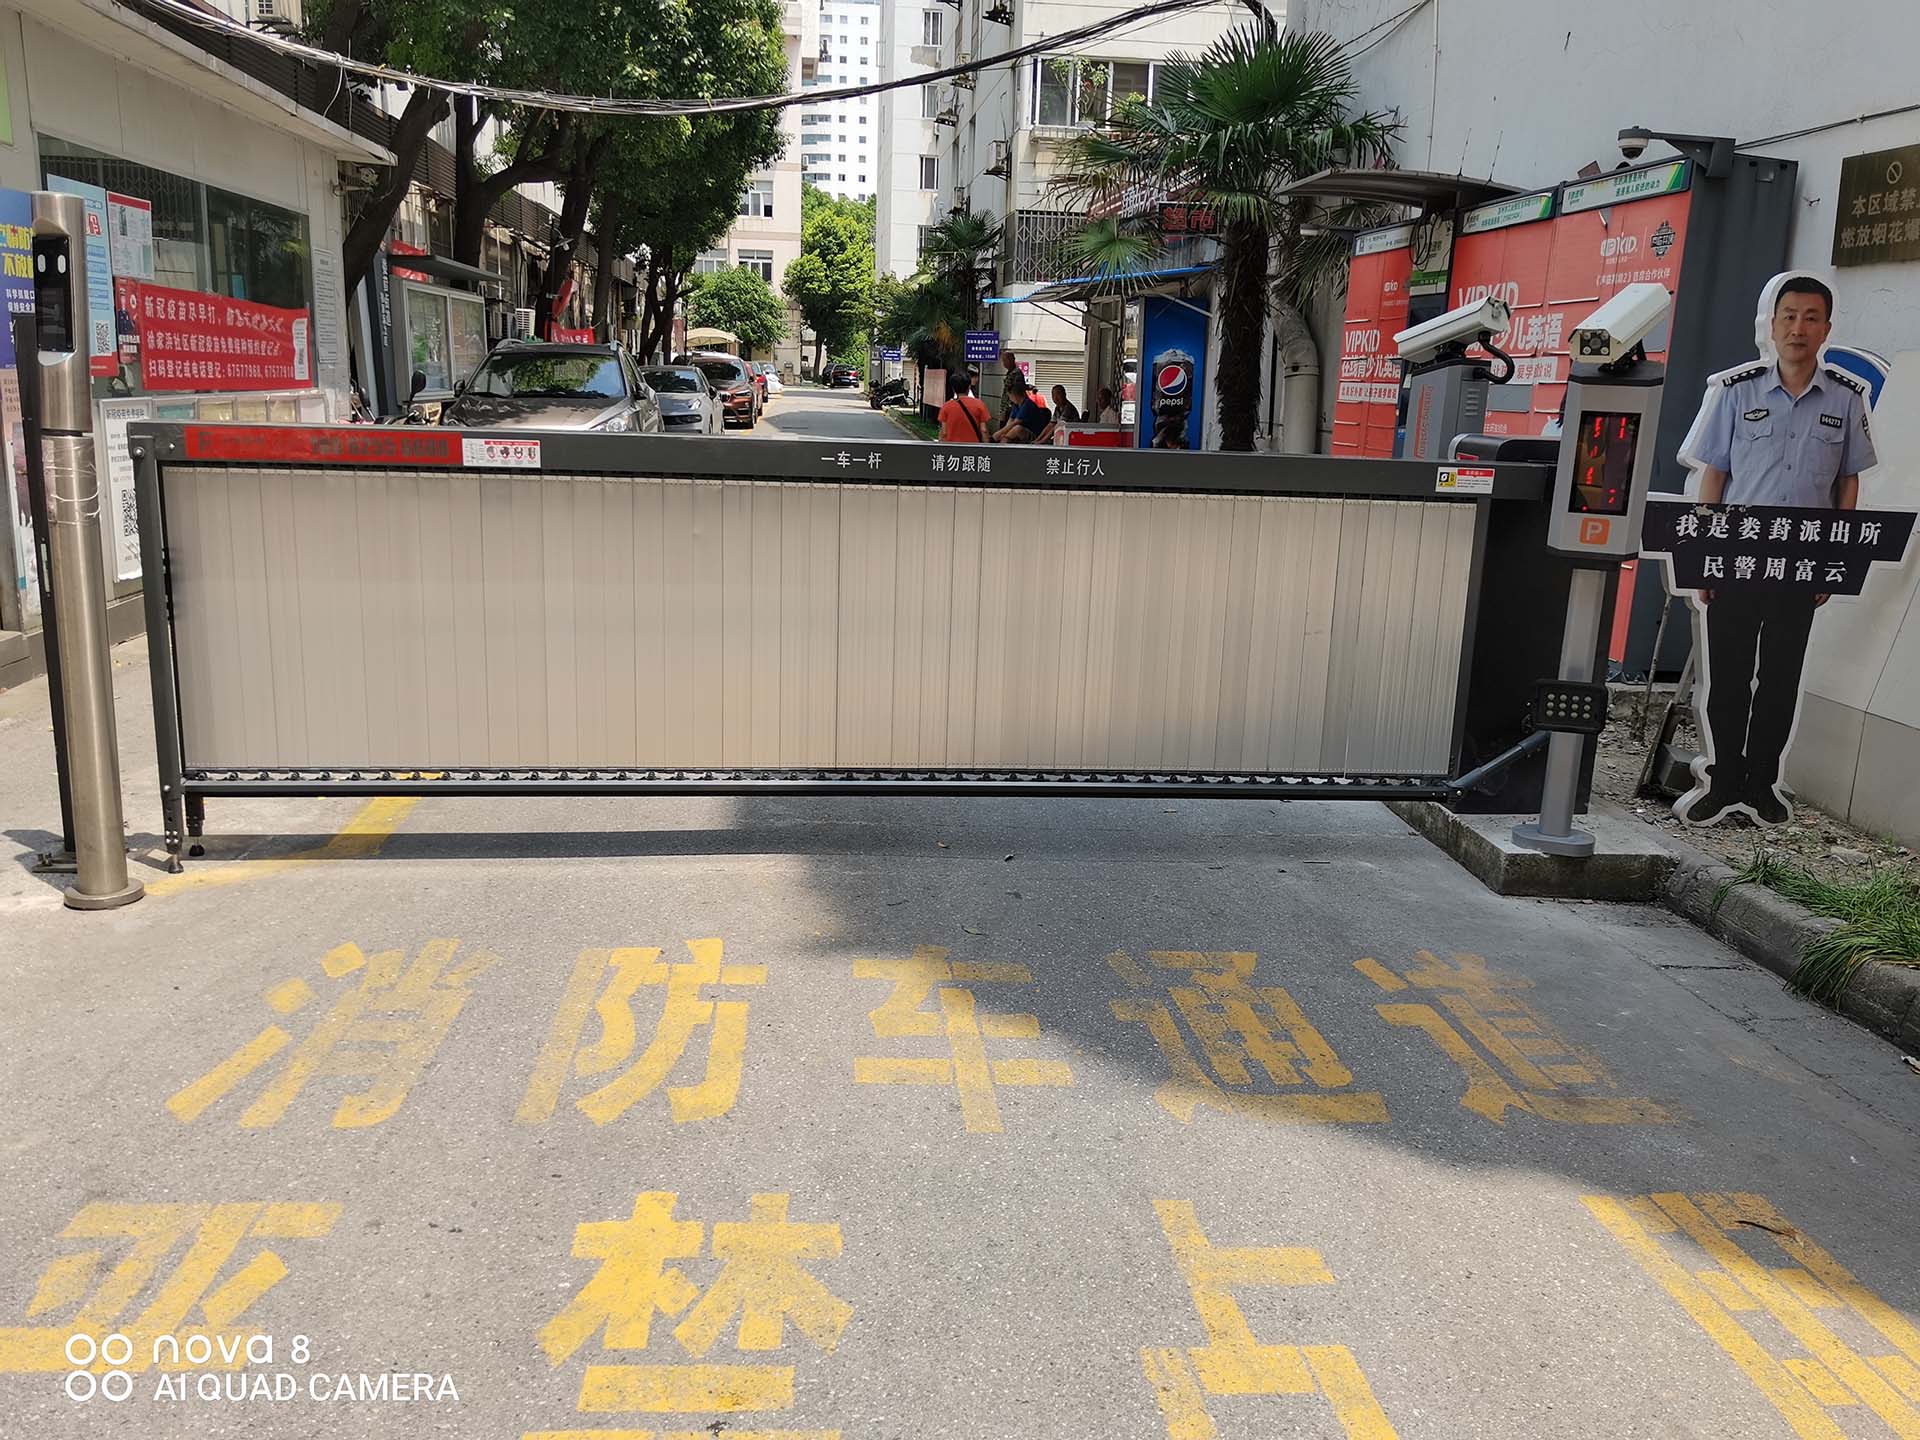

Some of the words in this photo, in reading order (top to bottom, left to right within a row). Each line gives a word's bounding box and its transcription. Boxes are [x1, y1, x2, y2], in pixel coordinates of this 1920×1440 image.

[1345, 330, 1381, 353] VIPKID
[1159, 397, 1184, 408] pepsi
[821, 451, 883, 470] 一车一杆
[931, 454, 992, 474] 请勿跟随
[1045, 457, 1105, 476] 禁止行人
[1586, 521, 1602, 542] P
[1675, 513, 1882, 546] 我是娄葑派出所
[1703, 555, 1848, 584] 民警周富云
[165, 937, 1690, 1135] 消防车通道
